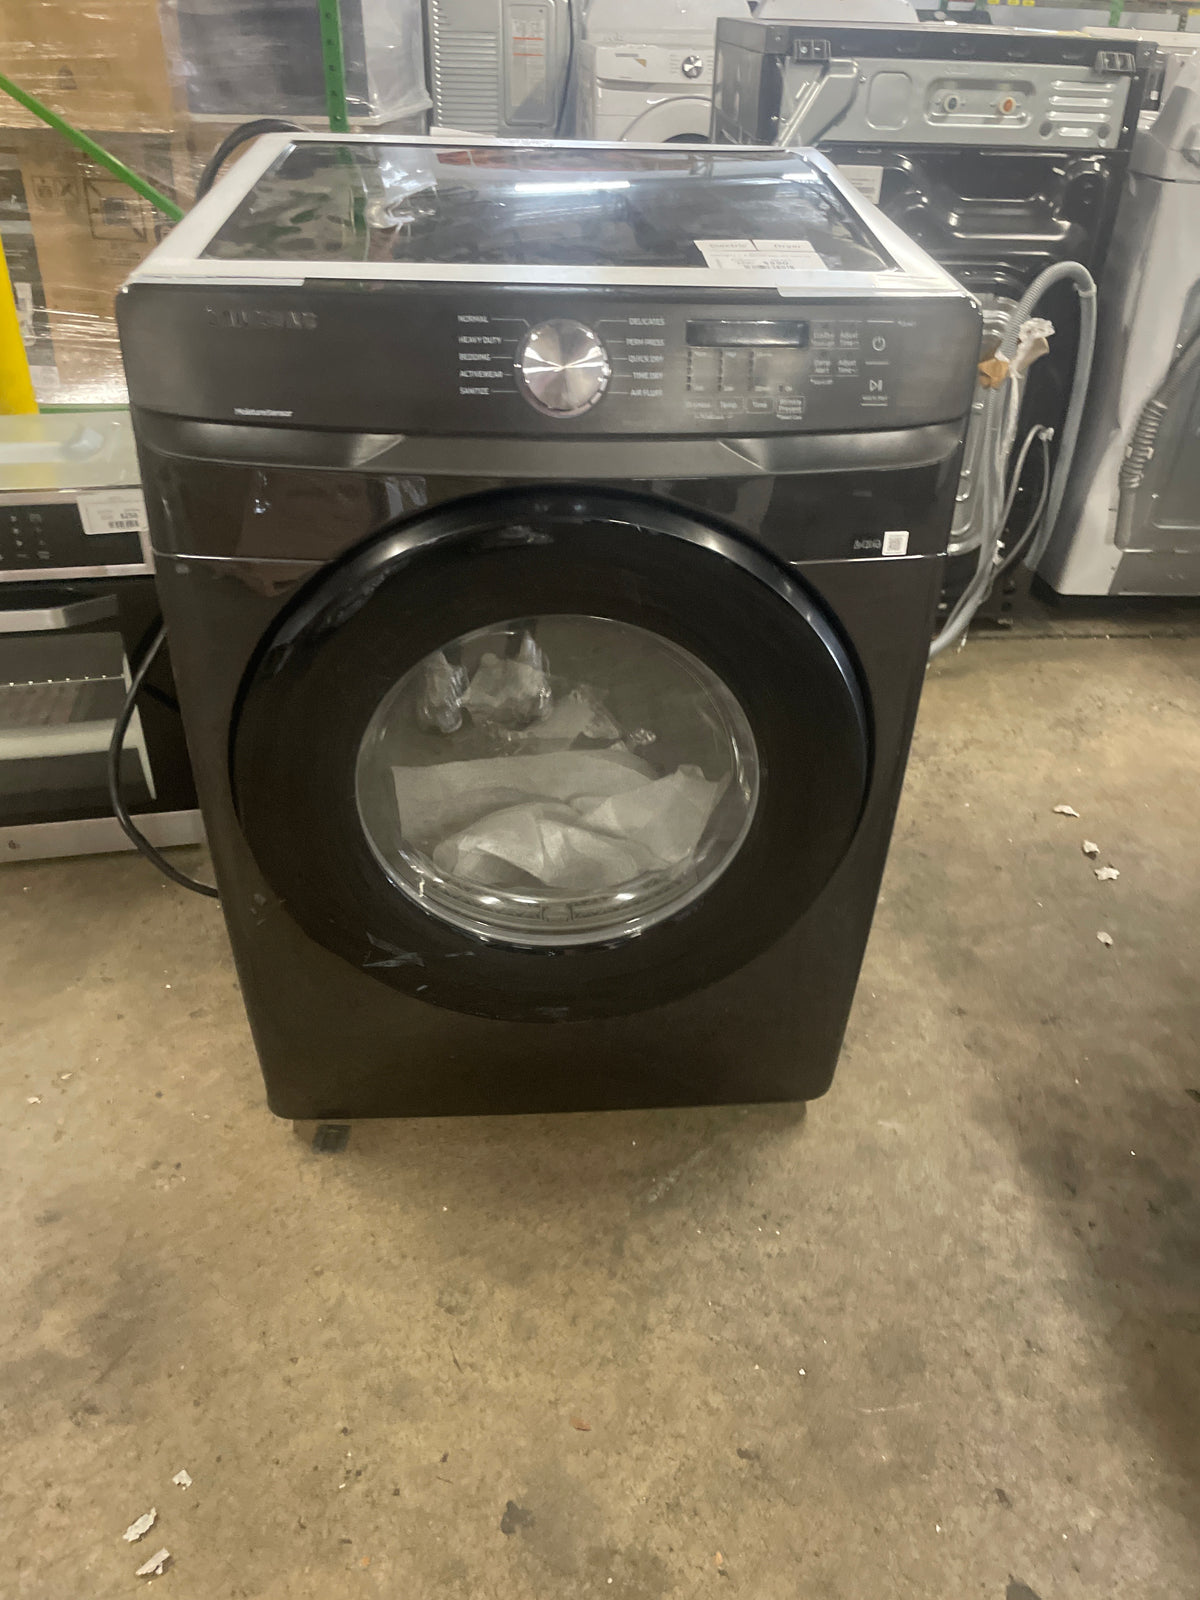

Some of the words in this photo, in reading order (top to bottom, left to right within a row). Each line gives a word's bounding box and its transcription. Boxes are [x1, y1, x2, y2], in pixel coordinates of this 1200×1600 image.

[457, 315, 489, 323] NORMAL
[458, 336, 482, 344] HEAVY
[482, 336, 502, 344] DUTY
[458, 353, 492, 361] BEDDING
[459, 387, 490, 395] SANITIZE
